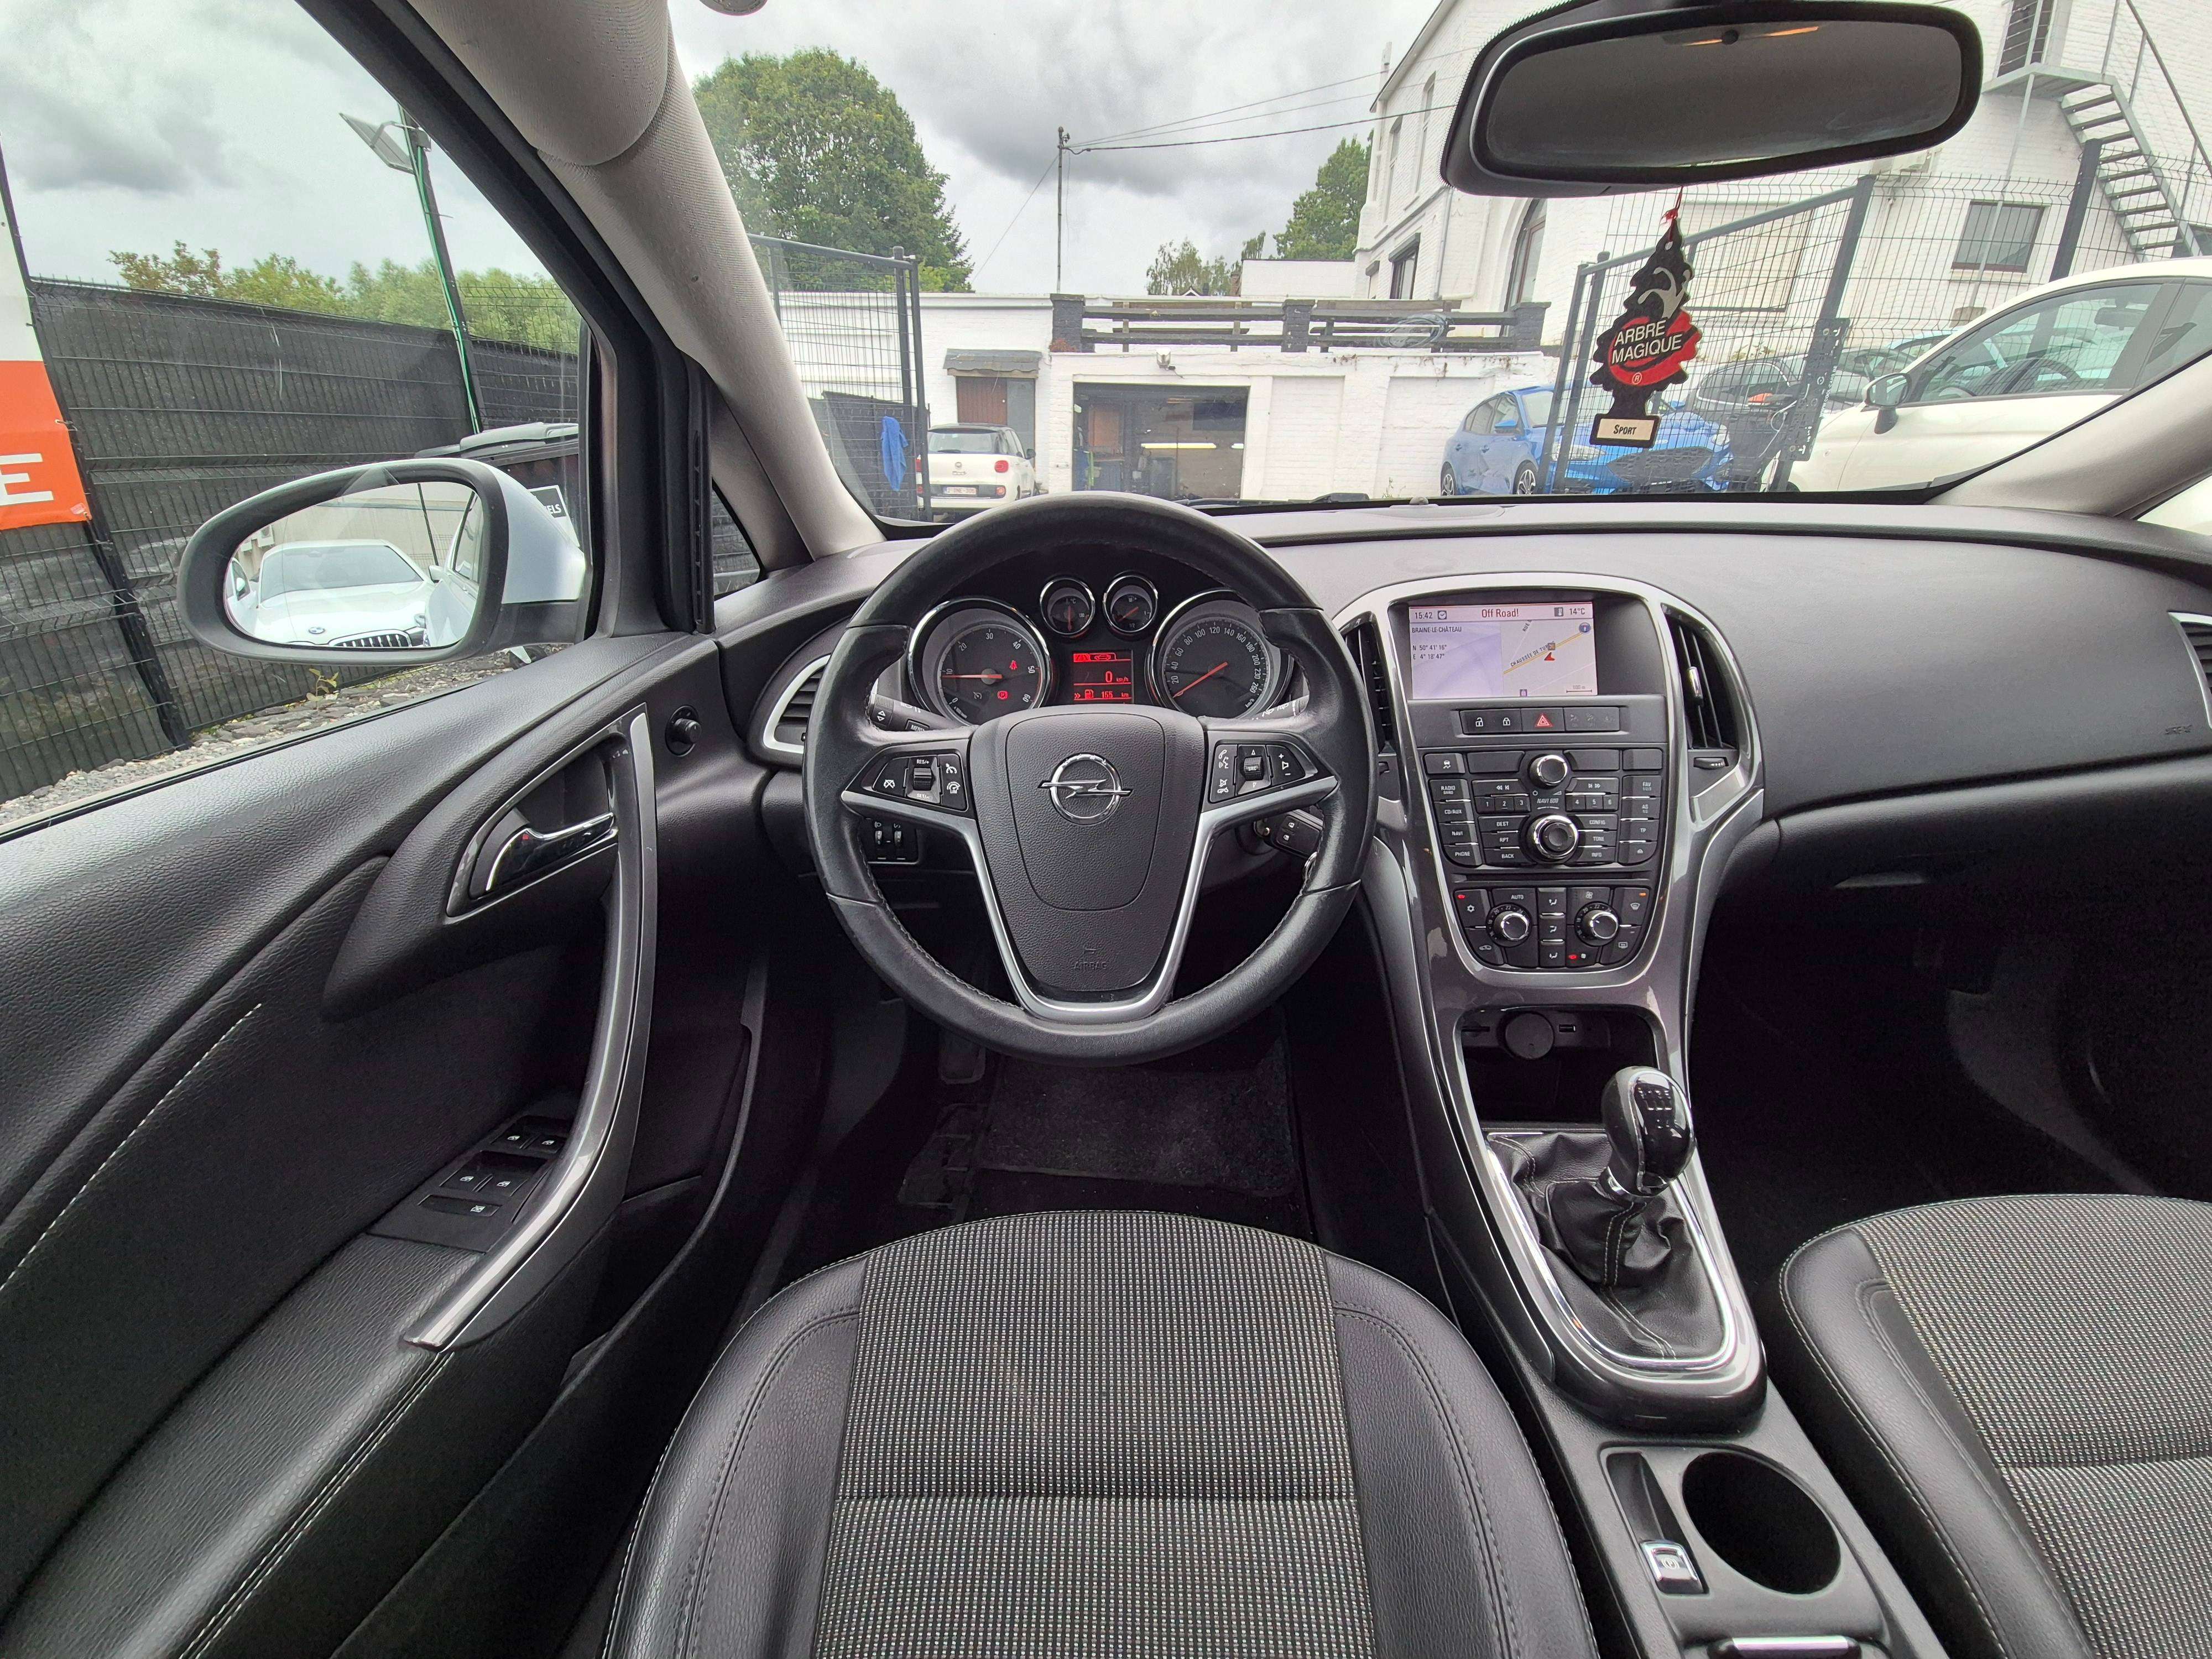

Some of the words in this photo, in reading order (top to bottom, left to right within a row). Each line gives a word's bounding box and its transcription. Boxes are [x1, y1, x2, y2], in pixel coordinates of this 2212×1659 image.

[1614, 319, 1667, 347] ARBRE
[1611, 333, 1683, 364] MAGIQUE
[1613, 424, 1637, 435] SPORT
[543, 504, 562, 514] ELS
[1481, 609, 1493, 618] Off
[1496, 608, 1519, 617] Road!
[1194, 629, 1206, 638] 100
[1209, 626, 1220, 634] 120
[1224, 627, 1235, 637] 140
[1184, 637, 1193, 645] 80
[1236, 633, 1246, 643] 160
[958, 642, 967, 651] 20
[1245, 641, 1255, 653] 180
[1175, 648, 1183, 657] 60
[1251, 654, 1261, 666] 200
[1510, 653, 1532, 667] CHAUSSÉE
[1027, 665, 1035, 674] 50
[1171, 661, 1179, 670] 40
[1105, 671, 1113, 683] 0
[1171, 675, 1179, 685] 20
[1249, 681, 1259, 693] 260
[1022, 693, 1031, 702] 60
